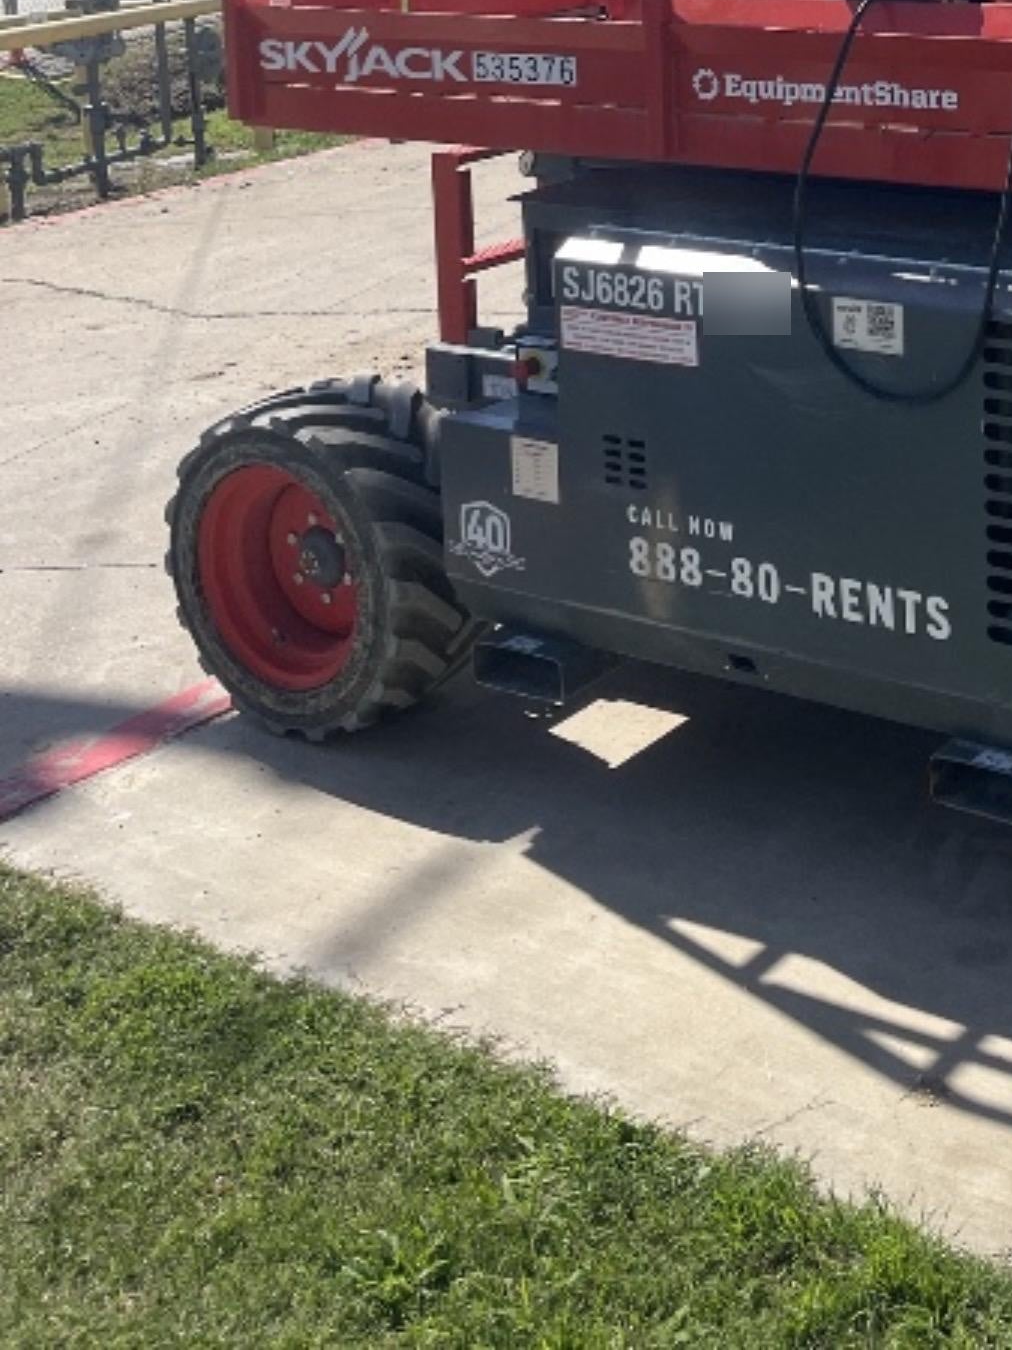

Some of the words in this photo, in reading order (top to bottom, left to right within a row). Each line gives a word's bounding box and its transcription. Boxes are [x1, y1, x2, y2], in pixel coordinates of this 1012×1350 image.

[259, 26, 468, 82] SKYJACK
[475, 53, 576, 85] 535376
[562, 266, 665, 310] SJ6826
[467, 508, 504, 552] 40
[627, 503, 679, 532] CALL
[688, 514, 734, 542] NOW
[629, 536, 952, 641] 888-80-RENTS
